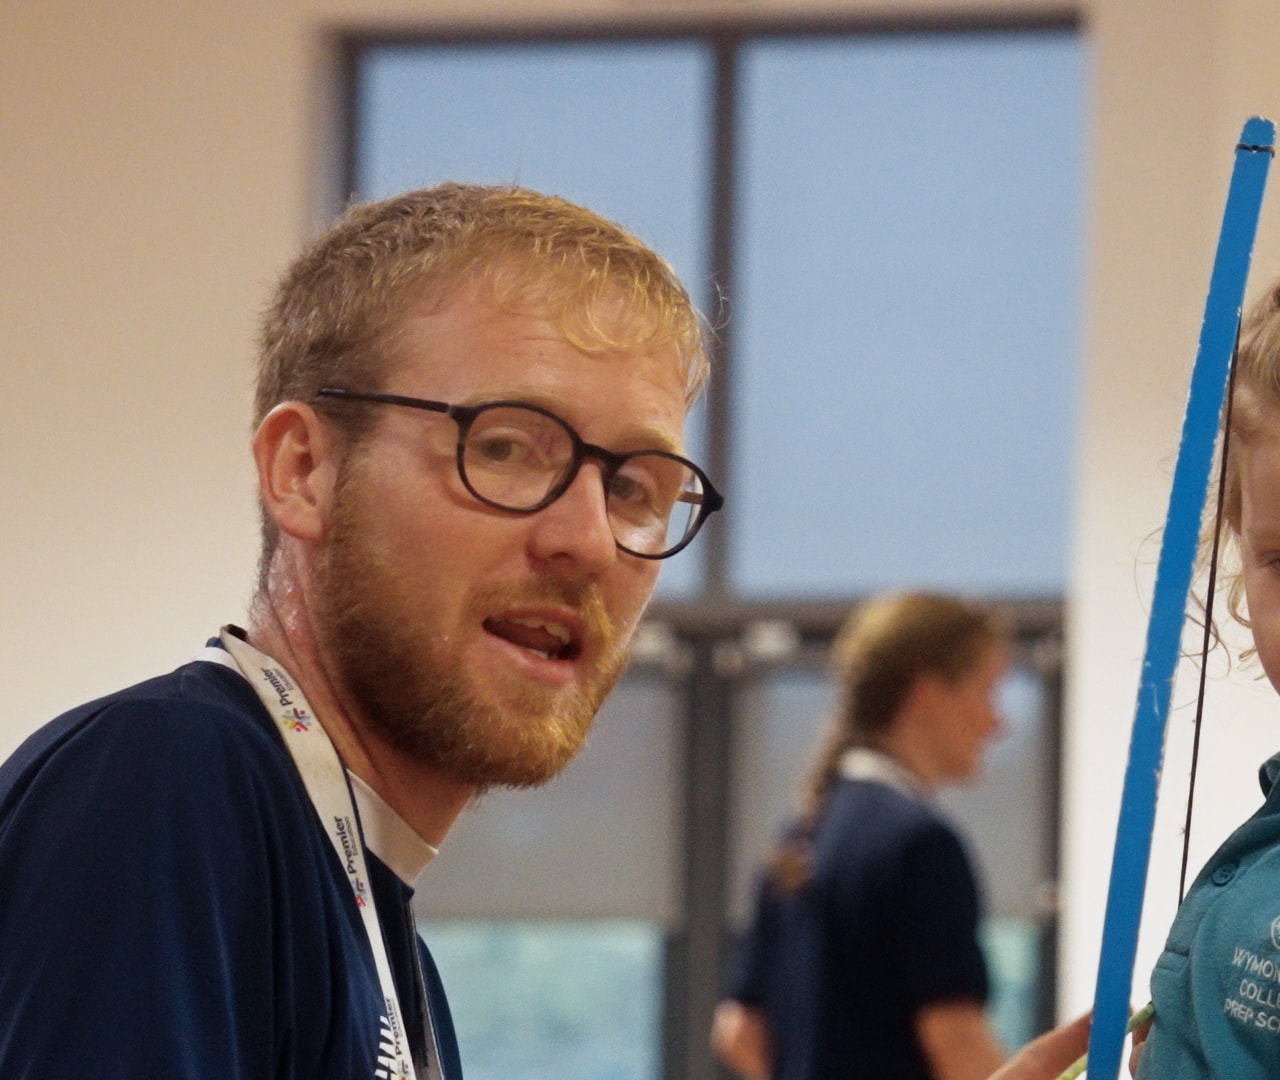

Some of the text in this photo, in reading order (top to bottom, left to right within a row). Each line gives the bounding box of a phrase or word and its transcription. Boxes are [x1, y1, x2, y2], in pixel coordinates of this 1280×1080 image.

[261, 667, 293, 706] Premier
[334, 815, 357, 874] Premier
[386, 998, 402, 1056] Premier
[1224, 998, 1254, 1023] PREP
